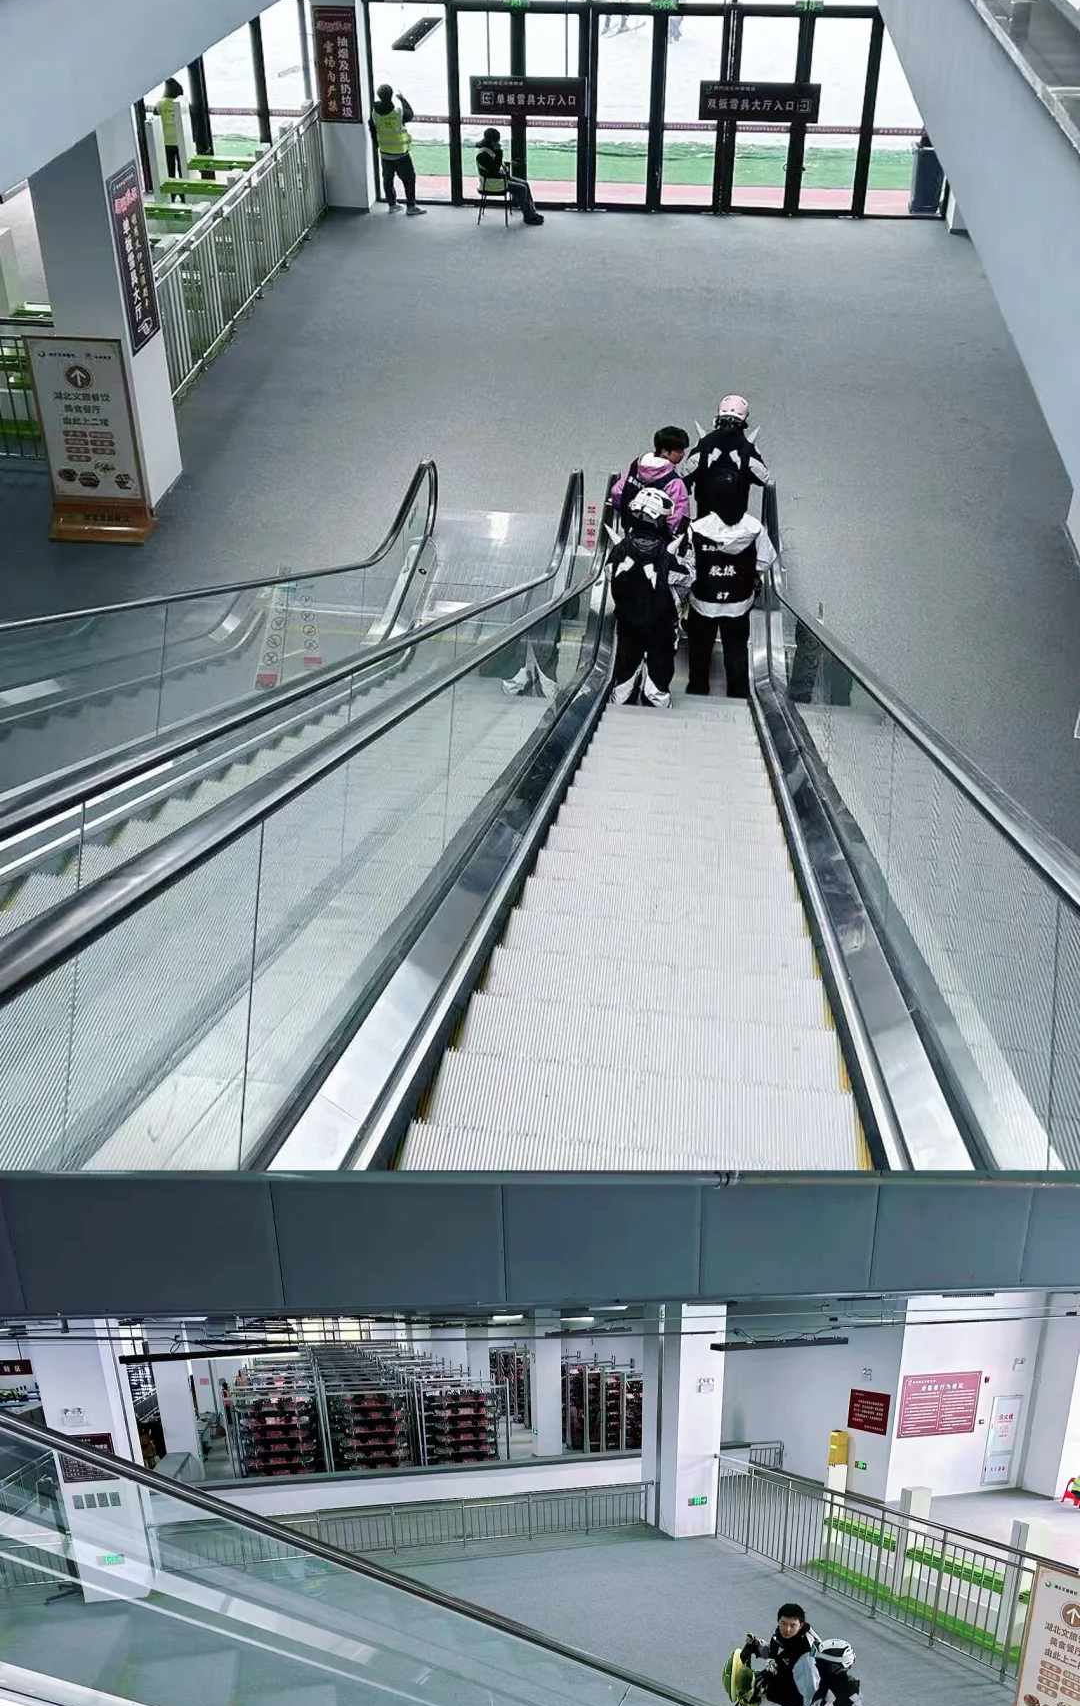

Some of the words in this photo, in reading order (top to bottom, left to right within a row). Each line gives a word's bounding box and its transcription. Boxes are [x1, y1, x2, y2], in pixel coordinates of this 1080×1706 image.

[496, 93, 577, 106] 单板雪具大厅入口
[707, 98, 794, 111] 双板雪具大厅入口
[1044, 1621, 1080, 1643] 湖北文旅
